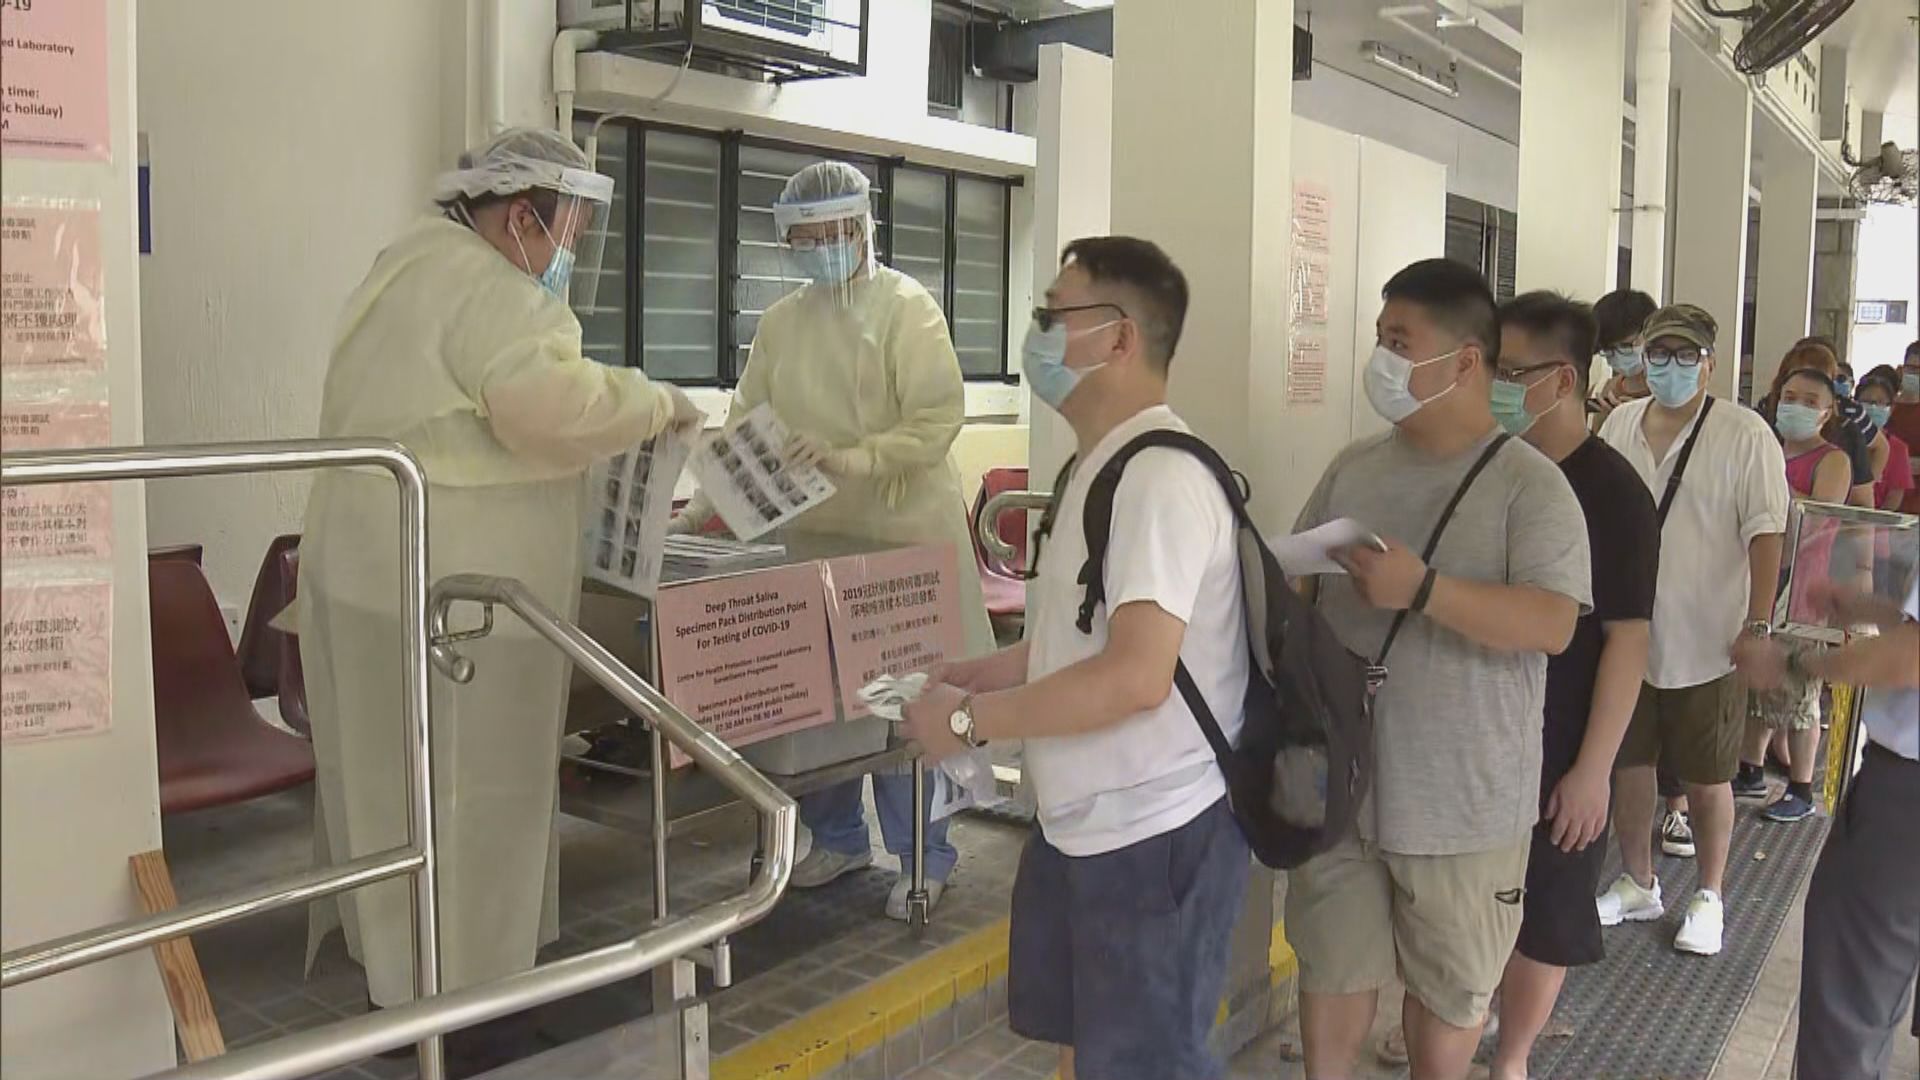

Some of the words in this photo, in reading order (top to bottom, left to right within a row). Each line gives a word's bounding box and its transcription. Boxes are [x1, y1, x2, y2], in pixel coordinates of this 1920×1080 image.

[0, 0, 31, 11] -19
[17, 39, 75, 57] Laboratory
[8, 86, 39, 98] time:
[15, 102, 63, 119] holiday)
[705, 600, 727, 614] Deep
[728, 595, 754, 610] Throat
[755, 591, 779, 605] Saliva
[675, 620, 717, 639] Specimen
[718, 614, 737, 630] Pack
[738, 607, 785, 624] Distribution
[786, 600, 807, 614] Point
[696, 636, 711, 650] For
[712, 631, 741, 646] Testing
[742, 628, 751, 639] of
[752, 620, 791, 638] COVID-19
[677, 672, 694, 683] Centre
[705, 664, 723, 675] Health
[724, 659, 752, 670] Protection
[756, 652, 782, 663] Enhanced
[783, 645, 812, 657] Laboratory
[713, 671, 746, 685] Surveillance
[747, 663, 778, 676] Programme
[698, 700, 727, 713] Specimen
[728, 695, 743, 706] pack
[744, 686, 779, 700] distribution
[721, 708, 740, 718] Friday
[764, 696, 783, 708] public
[784, 688, 809, 701] holiday)
[733, 719, 745, 729] AM
[771, 707, 783, 717] AM
